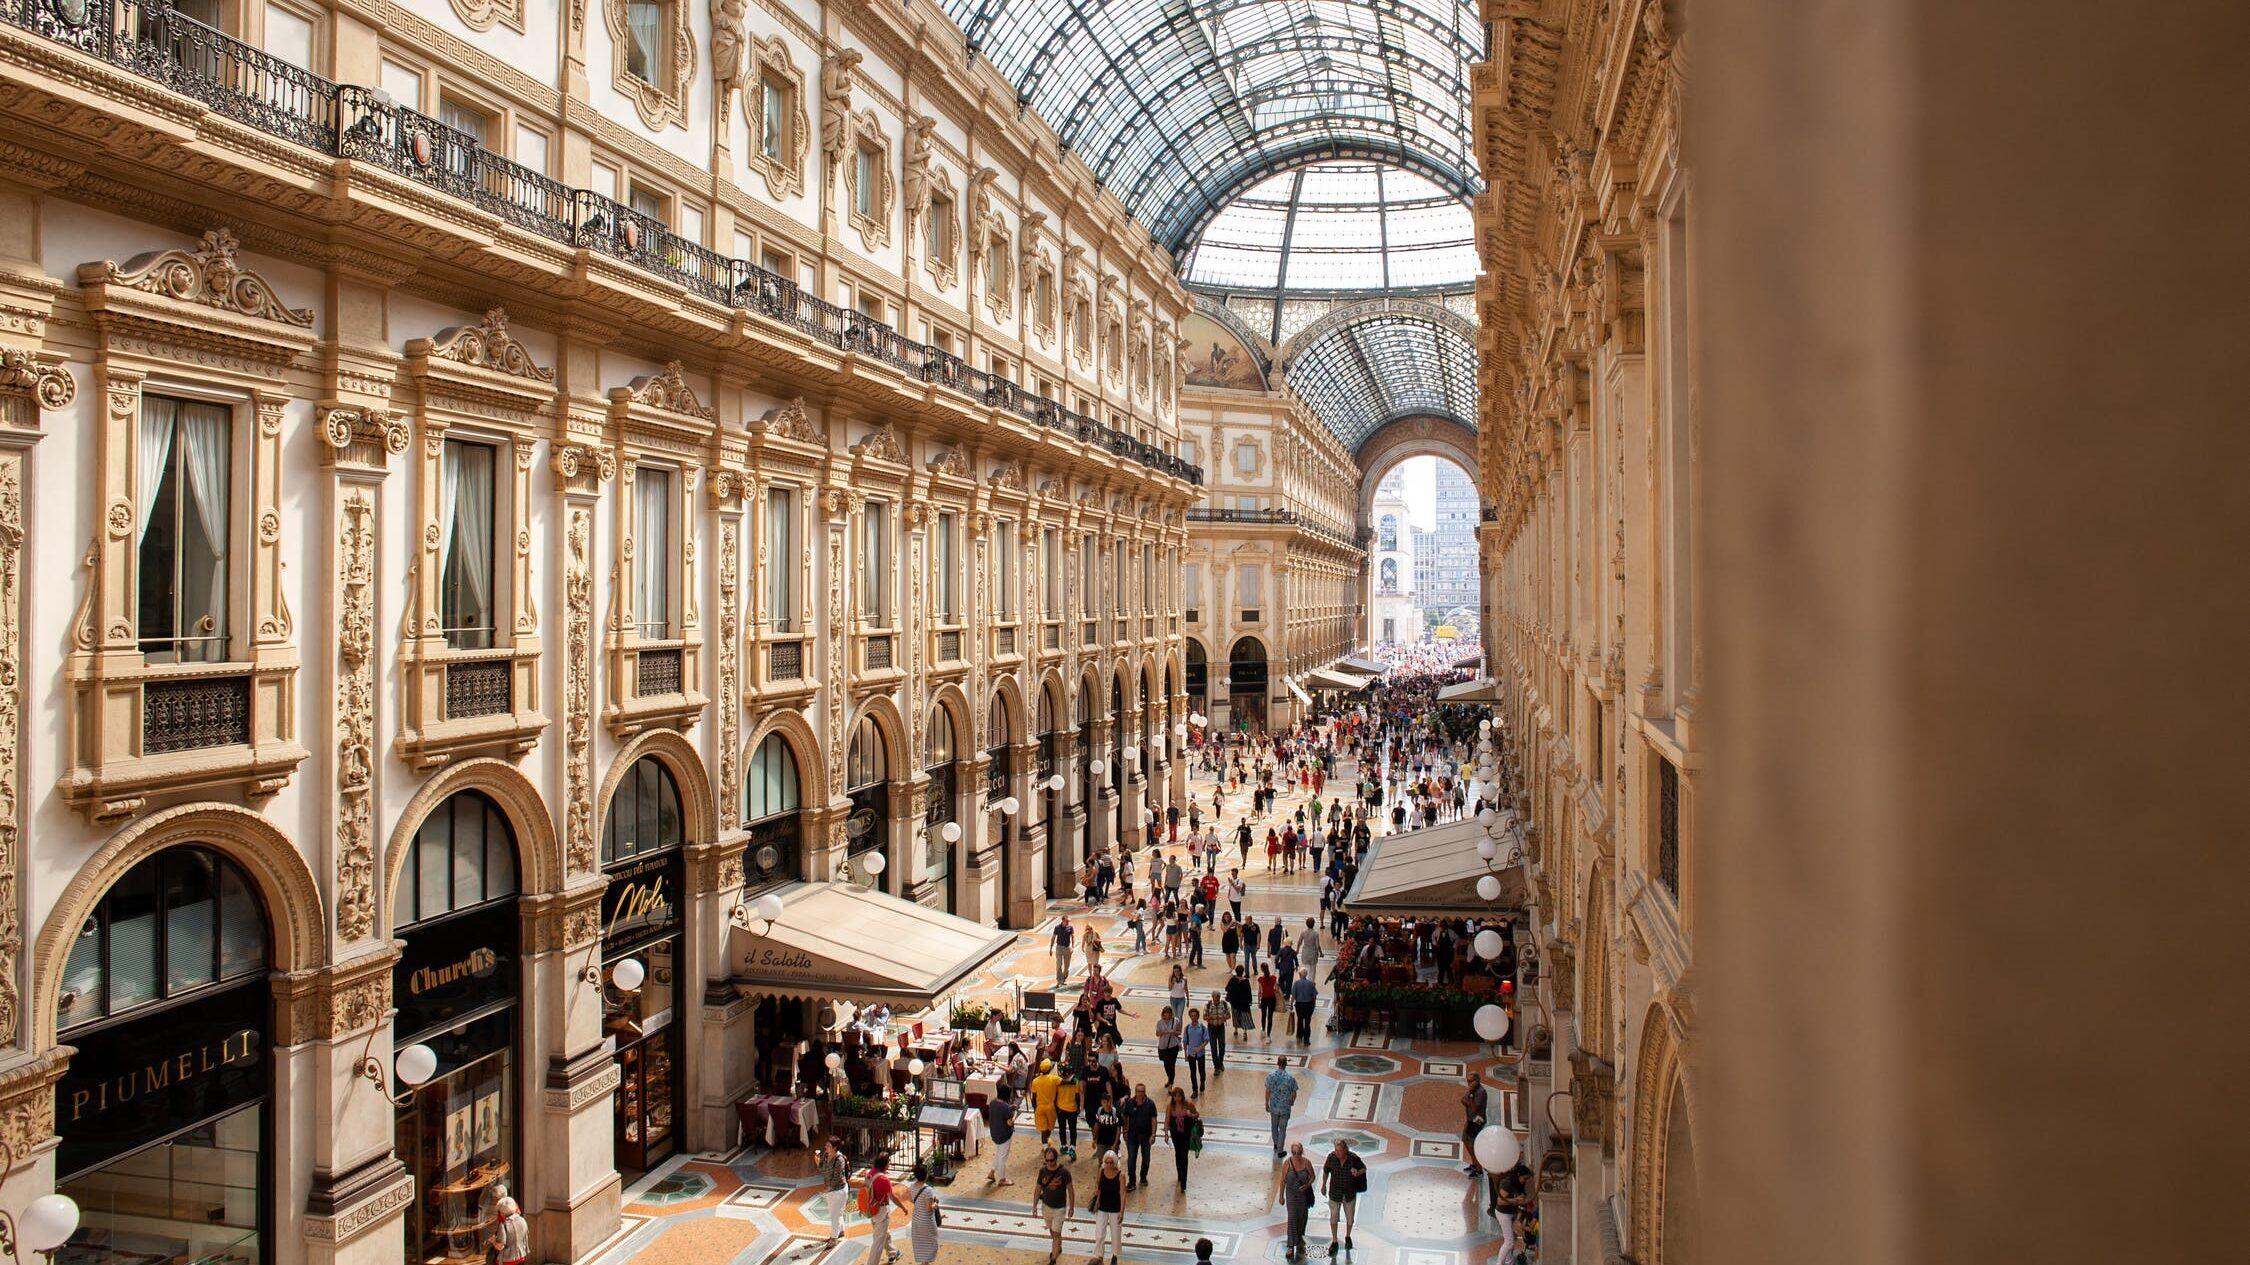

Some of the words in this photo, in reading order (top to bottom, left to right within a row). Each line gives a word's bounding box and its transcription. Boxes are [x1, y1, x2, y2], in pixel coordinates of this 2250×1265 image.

[410, 947, 496, 994] Church's
[744, 948, 757, 965] il
[760, 950, 812, 969] Salotto
[71, 1031, 250, 1121] PIUMELLI
